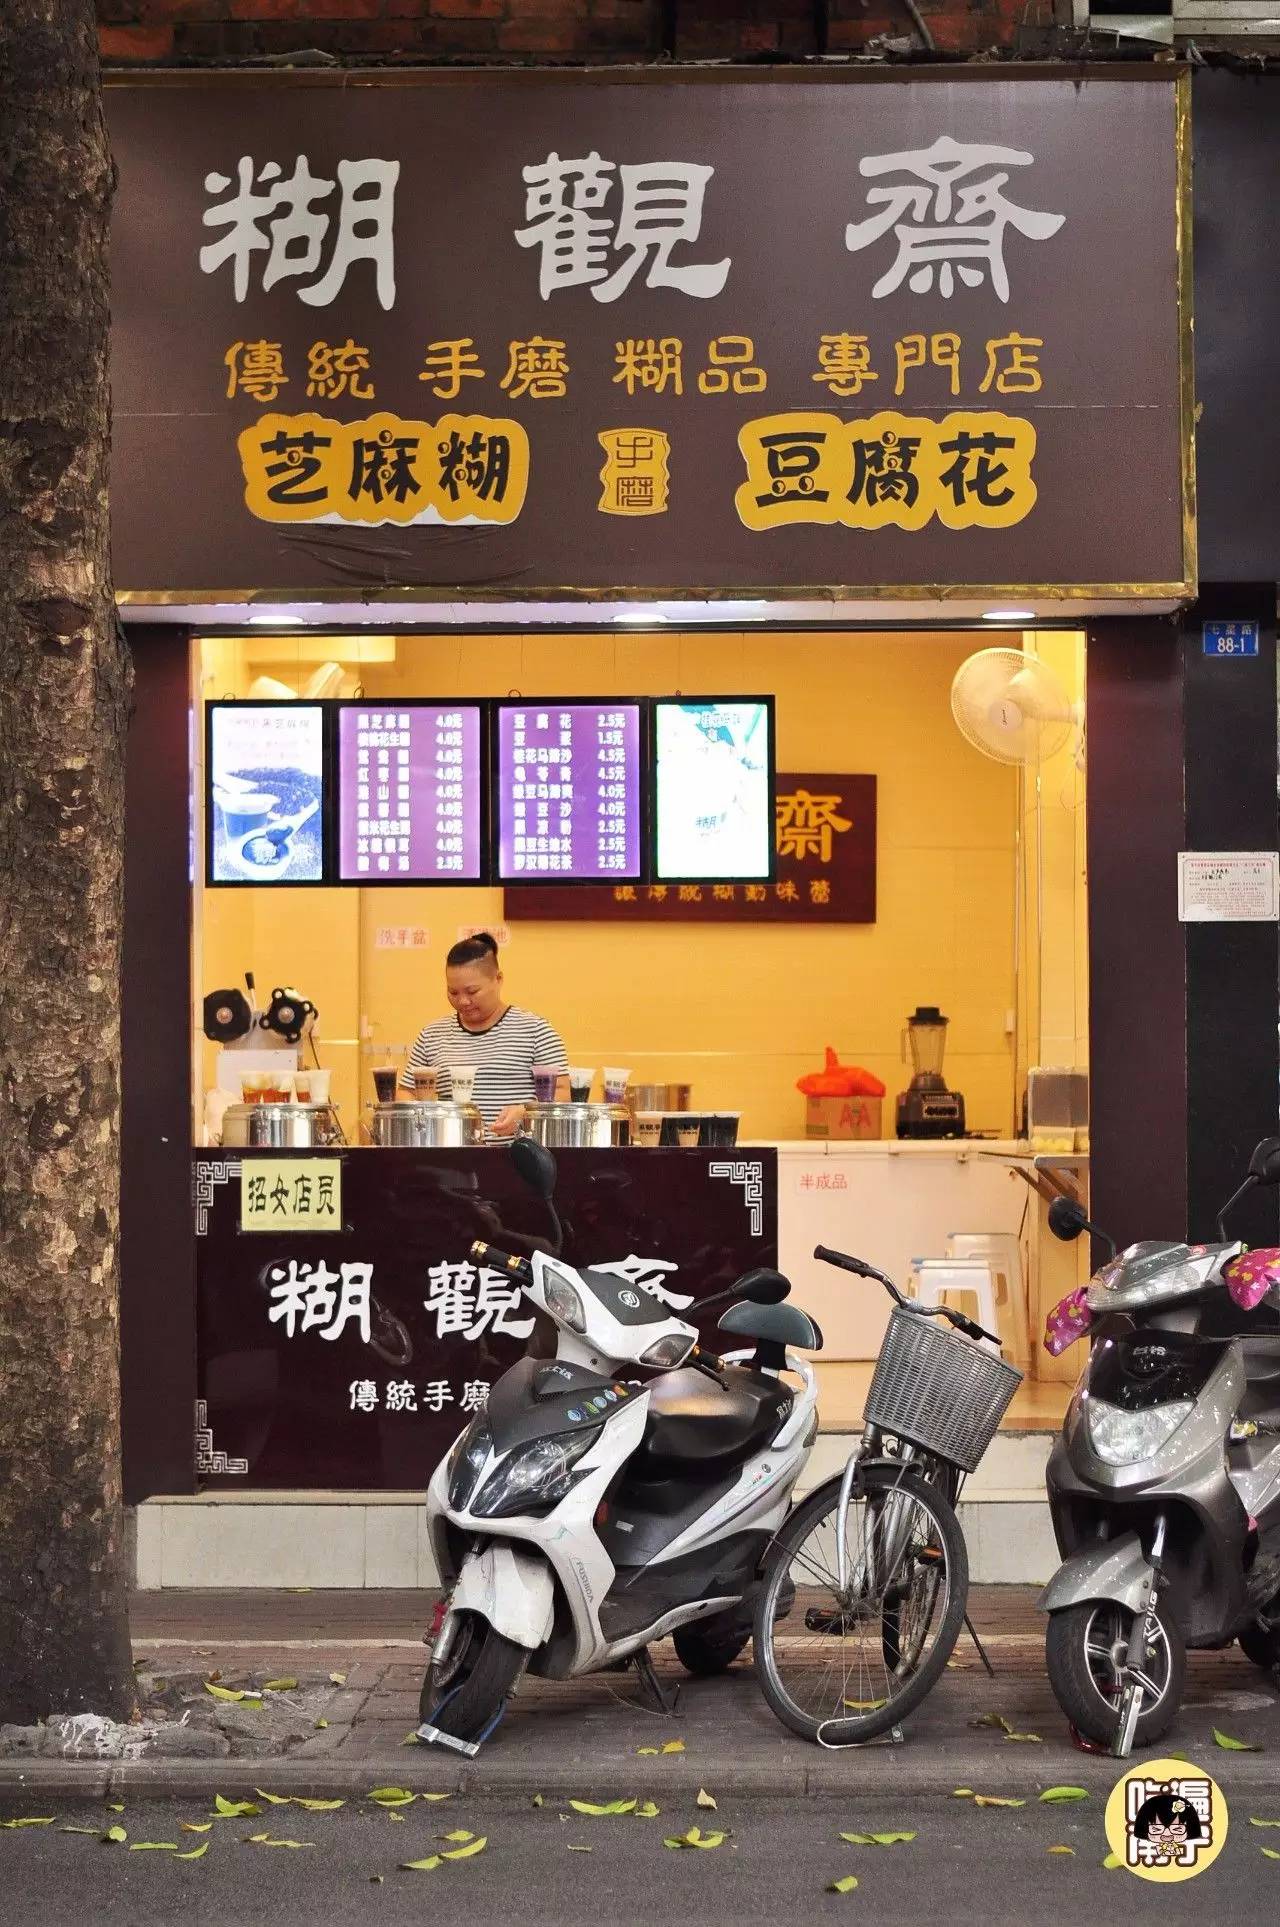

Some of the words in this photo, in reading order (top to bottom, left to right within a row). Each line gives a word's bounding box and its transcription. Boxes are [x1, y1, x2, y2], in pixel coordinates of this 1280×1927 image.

[200, 135, 1067, 311] 糊觀齋
[224, 333, 1045, 402] 傳統手磨糊品專門店
[259, 431, 511, 505] 芝麻糊
[755, 430, 1017, 510] 豆腐花
[1217, 637, 1245, 653] 88-1
[598, 713, 625, 728] 2.5元
[598, 730, 624, 745] 1.5元
[598, 747, 625, 763] 4.5元
[598, 765, 625, 781] 4.5元
[598, 783, 625, 798] 4.0元
[598, 801, 625, 817] 4.0元
[598, 818, 625, 834] 2.5元
[598, 836, 625, 851] 2.5元
[598, 853, 625, 869] 2.5元
[799, 1173, 848, 1190] 半成品
[248, 1173, 335, 1215] 招女店员
